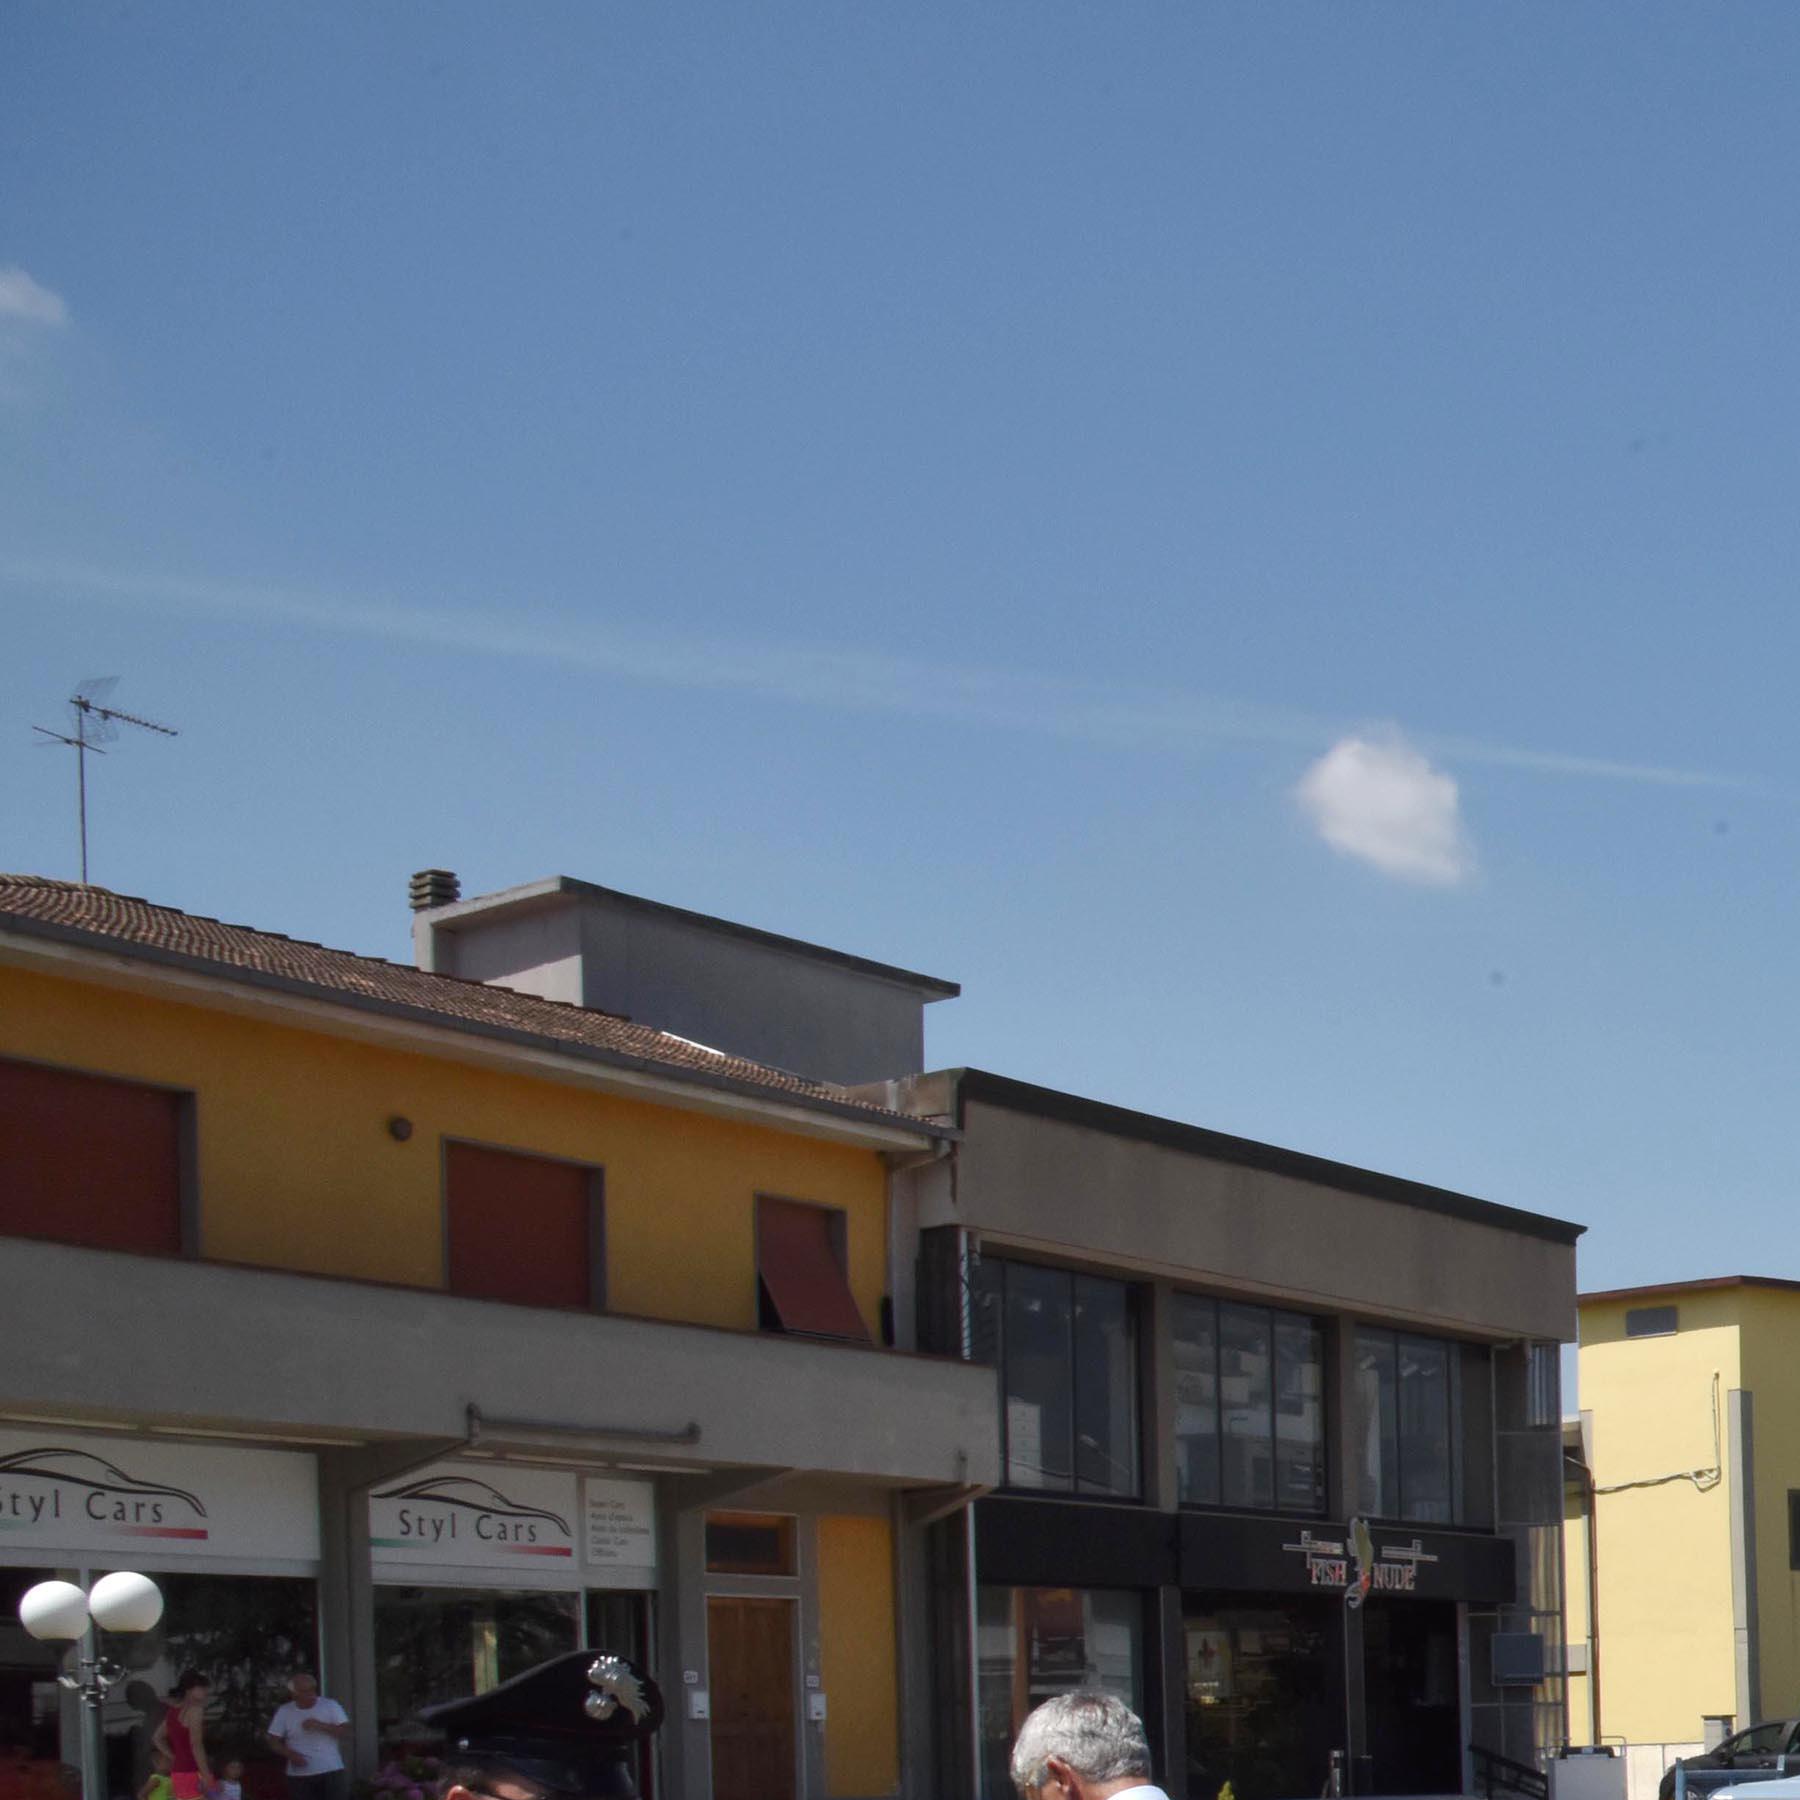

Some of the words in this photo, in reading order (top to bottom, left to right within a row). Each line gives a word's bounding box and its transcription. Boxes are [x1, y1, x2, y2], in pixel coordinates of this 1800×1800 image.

[0, 1487, 60, 1524] tyl
[85, 1490, 163, 1524] Cars
[399, 1508, 456, 1543] Styl
[475, 1513, 537, 1543] Cars
[1311, 1558, 1347, 1586] FISH
[1373, 1563, 1415, 1590] NUDE
